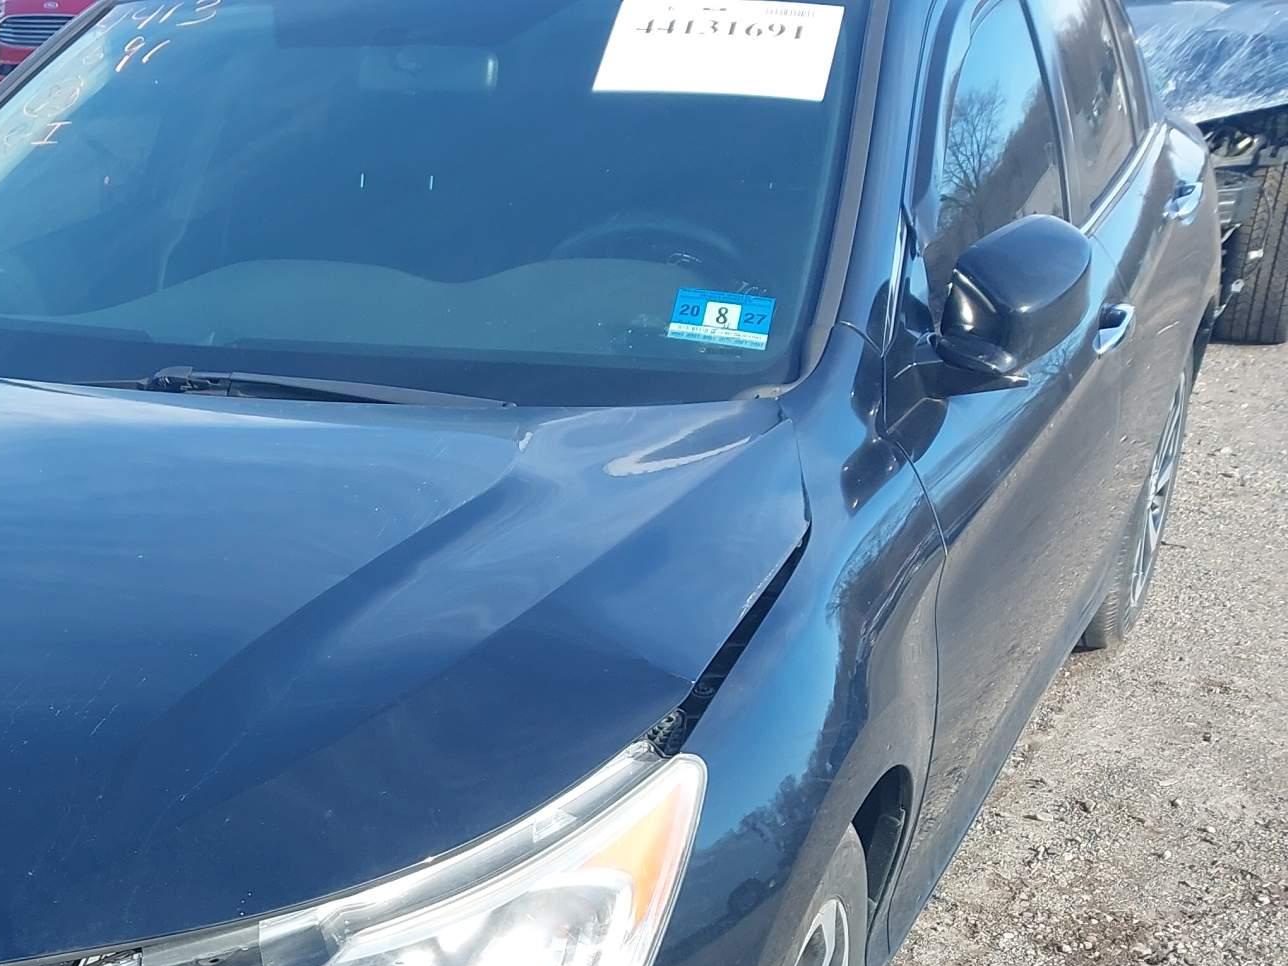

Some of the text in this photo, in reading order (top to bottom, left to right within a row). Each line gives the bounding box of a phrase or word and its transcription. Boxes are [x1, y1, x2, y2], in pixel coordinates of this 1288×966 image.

[635, 18, 804, 40] 44131691
[678, 303, 768, 325] 20 8 27
